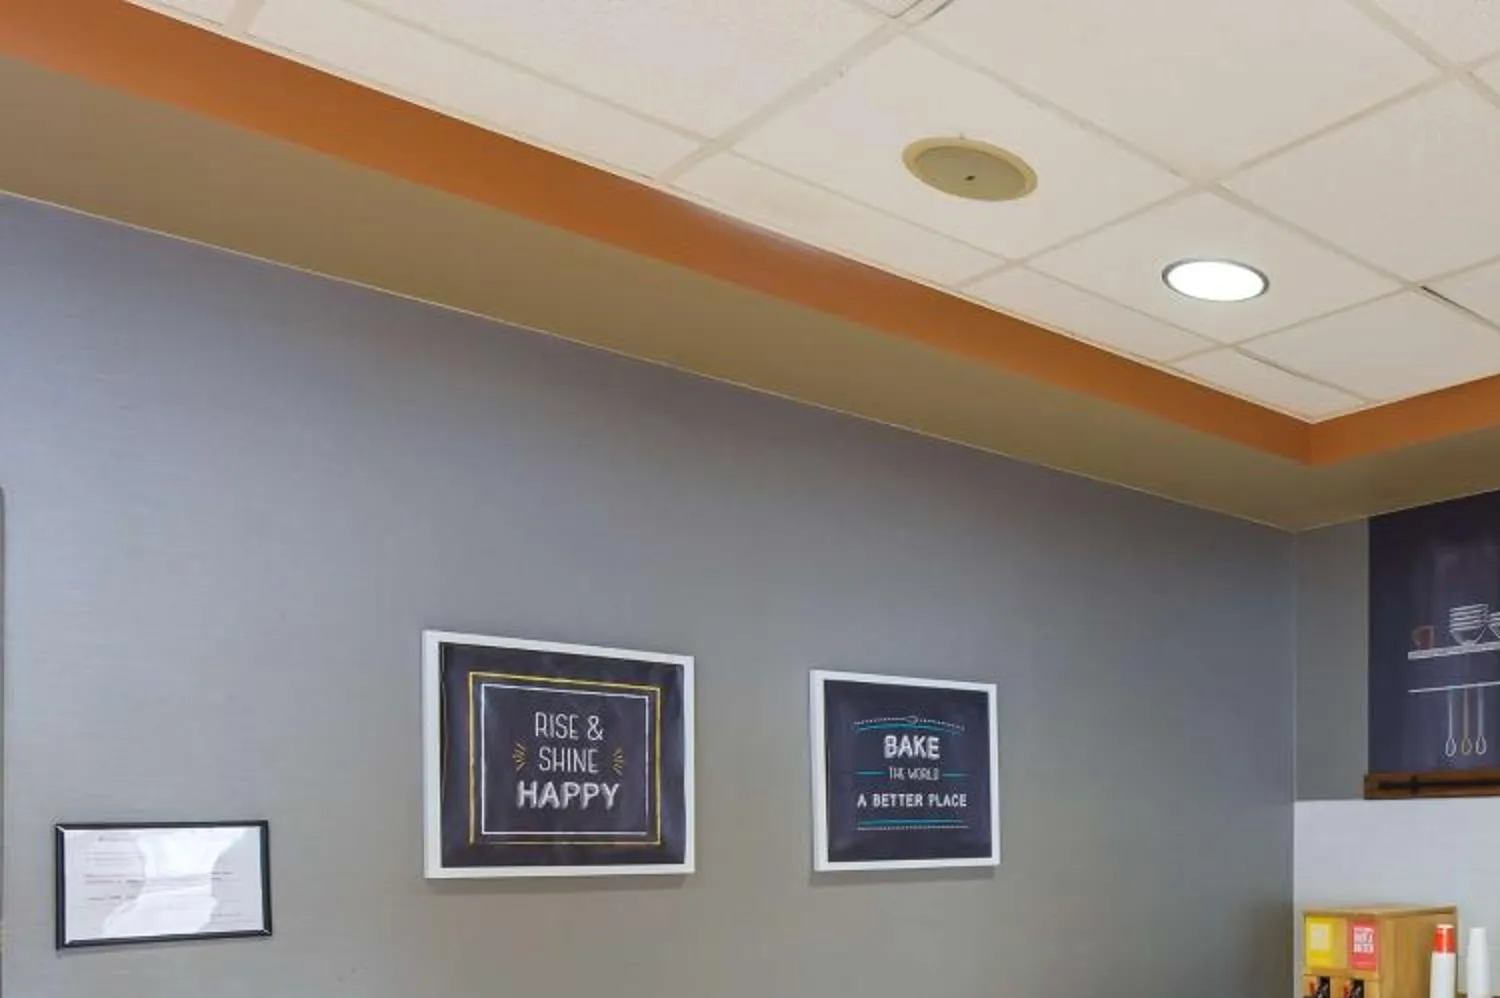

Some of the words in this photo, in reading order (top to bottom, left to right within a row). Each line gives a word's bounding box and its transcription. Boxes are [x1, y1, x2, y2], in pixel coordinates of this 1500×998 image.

[535, 711, 580, 740] RISE
[586, 715, 604, 741] &
[539, 745, 600, 774] SHINE
[883, 734, 941, 760] BAKE
[888, 766, 906, 780] THE
[907, 767, 940, 781] WORLD
[516, 780, 620, 811] HAPPY
[857, 793, 867, 809] A
[872, 793, 924, 808] BETTER
[927, 793, 968, 808] PLACE
